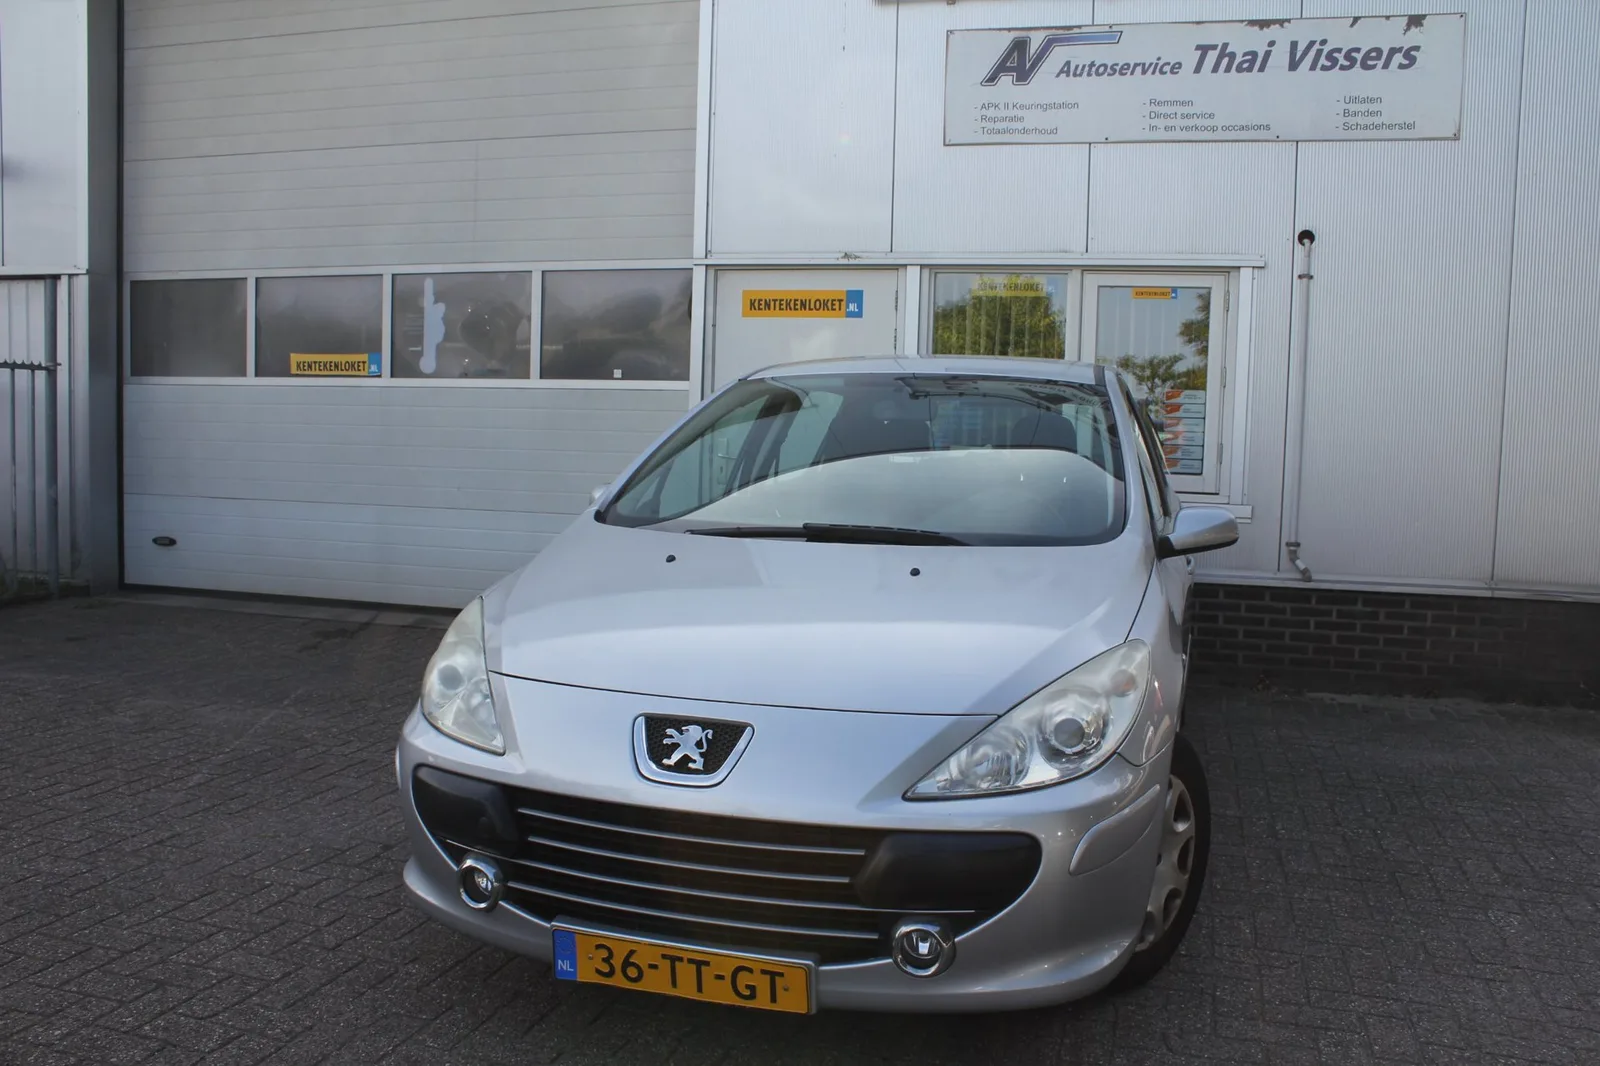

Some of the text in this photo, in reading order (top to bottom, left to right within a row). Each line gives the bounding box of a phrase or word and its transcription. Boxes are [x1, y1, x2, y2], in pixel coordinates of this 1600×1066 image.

[1055, 38, 1421, 78] Autoservice Thai Vissers
[1149, 98, 1194, 107] Remmen
[1343, 95, 1383, 105] Uitlaten
[980, 102, 1001, 111] APK
[1012, 100, 1079, 112] Keuringstation
[1149, 110, 1215, 120] Direct service
[1343, 108, 1383, 118] Banden
[980, 114, 1025, 124] Reparatie
[981, 126, 1058, 135] Totaalonderhoud
[1148, 123, 1161, 132] In-
[1180, 123, 1218, 133] verkoop
[1221, 122, 1271, 132] occasions
[1342, 120, 1416, 131] Schadeherstel
[749, 298, 859, 312] KENTEKENLOKET .NL
[296, 360, 367, 372] KENTEKENLOKET
[557, 943, 784, 1004] NL 36-TT-GT
